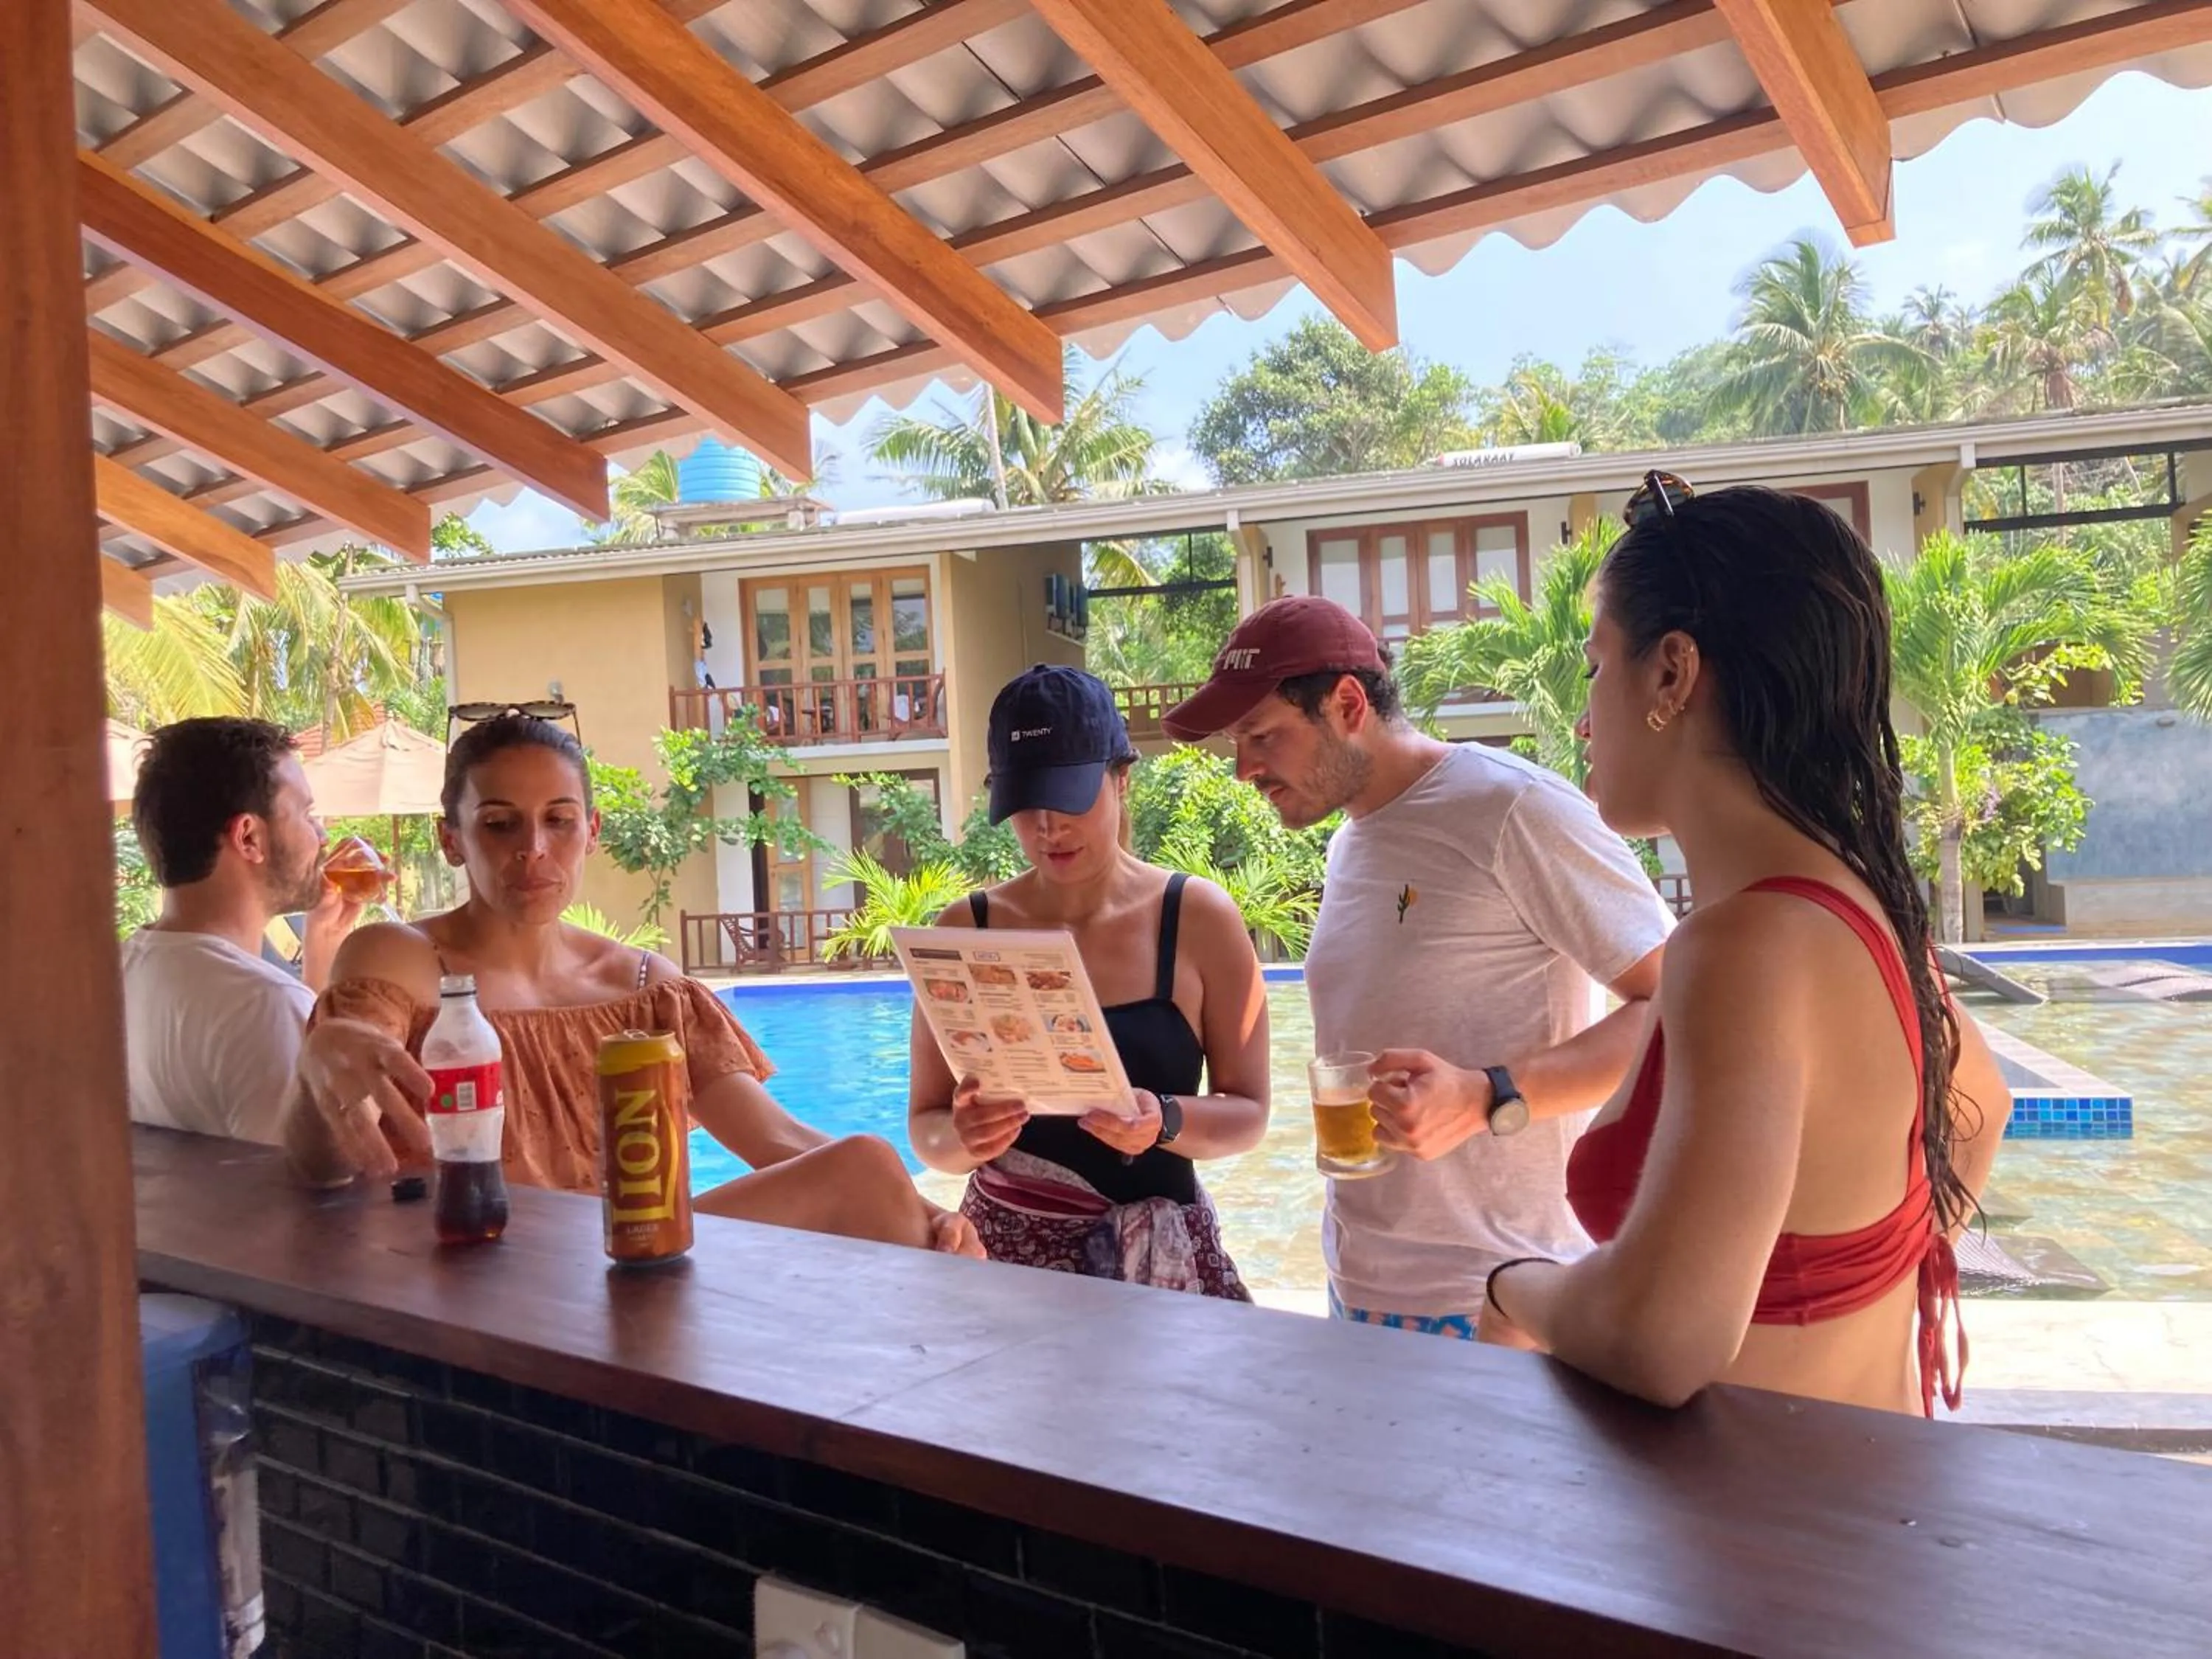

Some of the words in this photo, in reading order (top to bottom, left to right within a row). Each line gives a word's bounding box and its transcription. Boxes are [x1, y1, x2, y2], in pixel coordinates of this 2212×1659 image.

[1223, 649, 1260, 669] MIT
[1022, 727, 1052, 737] TWENTY
[614, 1089, 675, 1222] LION
